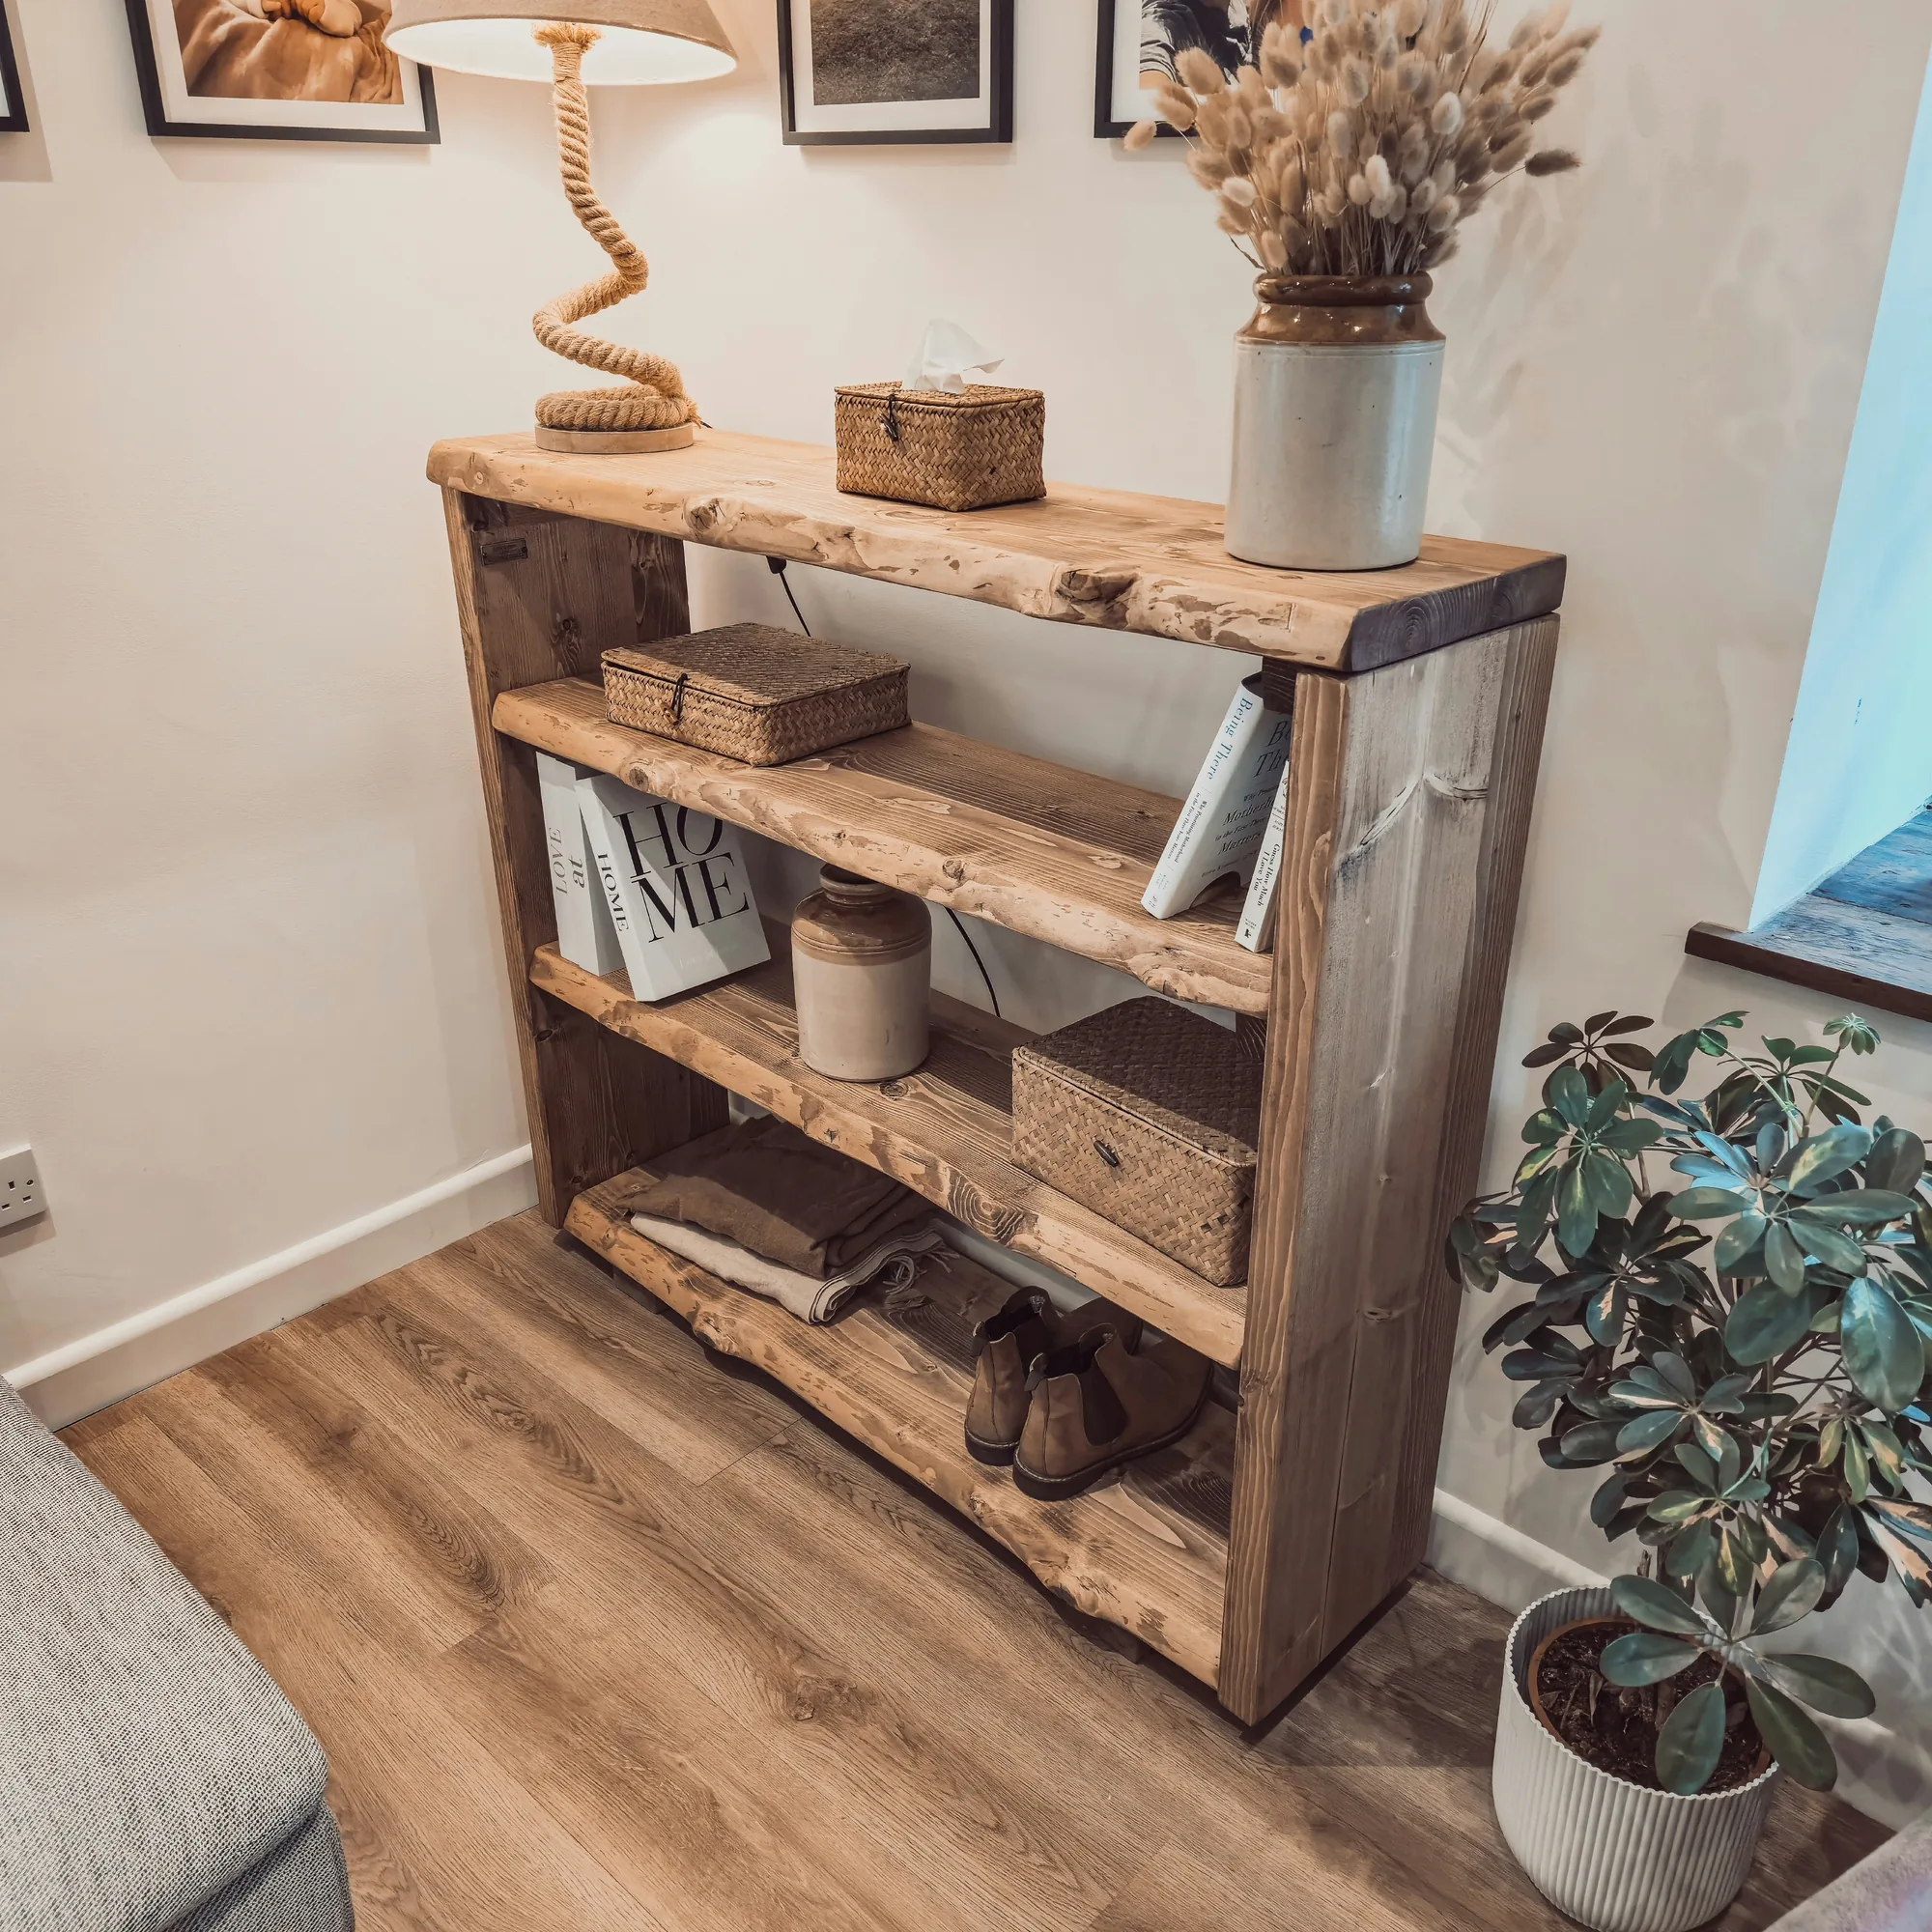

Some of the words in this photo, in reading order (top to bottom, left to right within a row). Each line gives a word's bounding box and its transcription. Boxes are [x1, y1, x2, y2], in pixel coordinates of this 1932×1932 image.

[1225, 697, 1253, 737] Being
[1207, 742, 1233, 780] There
[612, 802, 724, 879] HO
[1217, 832, 1261, 855] Matters
[1269, 843, 1281, 866] Guess
[549, 827, 568, 895] LOVE
[568, 854, 585, 889] at
[1258, 857, 1268, 875] Love
[1264, 867, 1274, 884] How
[597, 853, 630, 932] HOME
[630, 851, 751, 944] ME
[1253, 877, 1263, 892] You
[1258, 886, 1268, 907] Much
